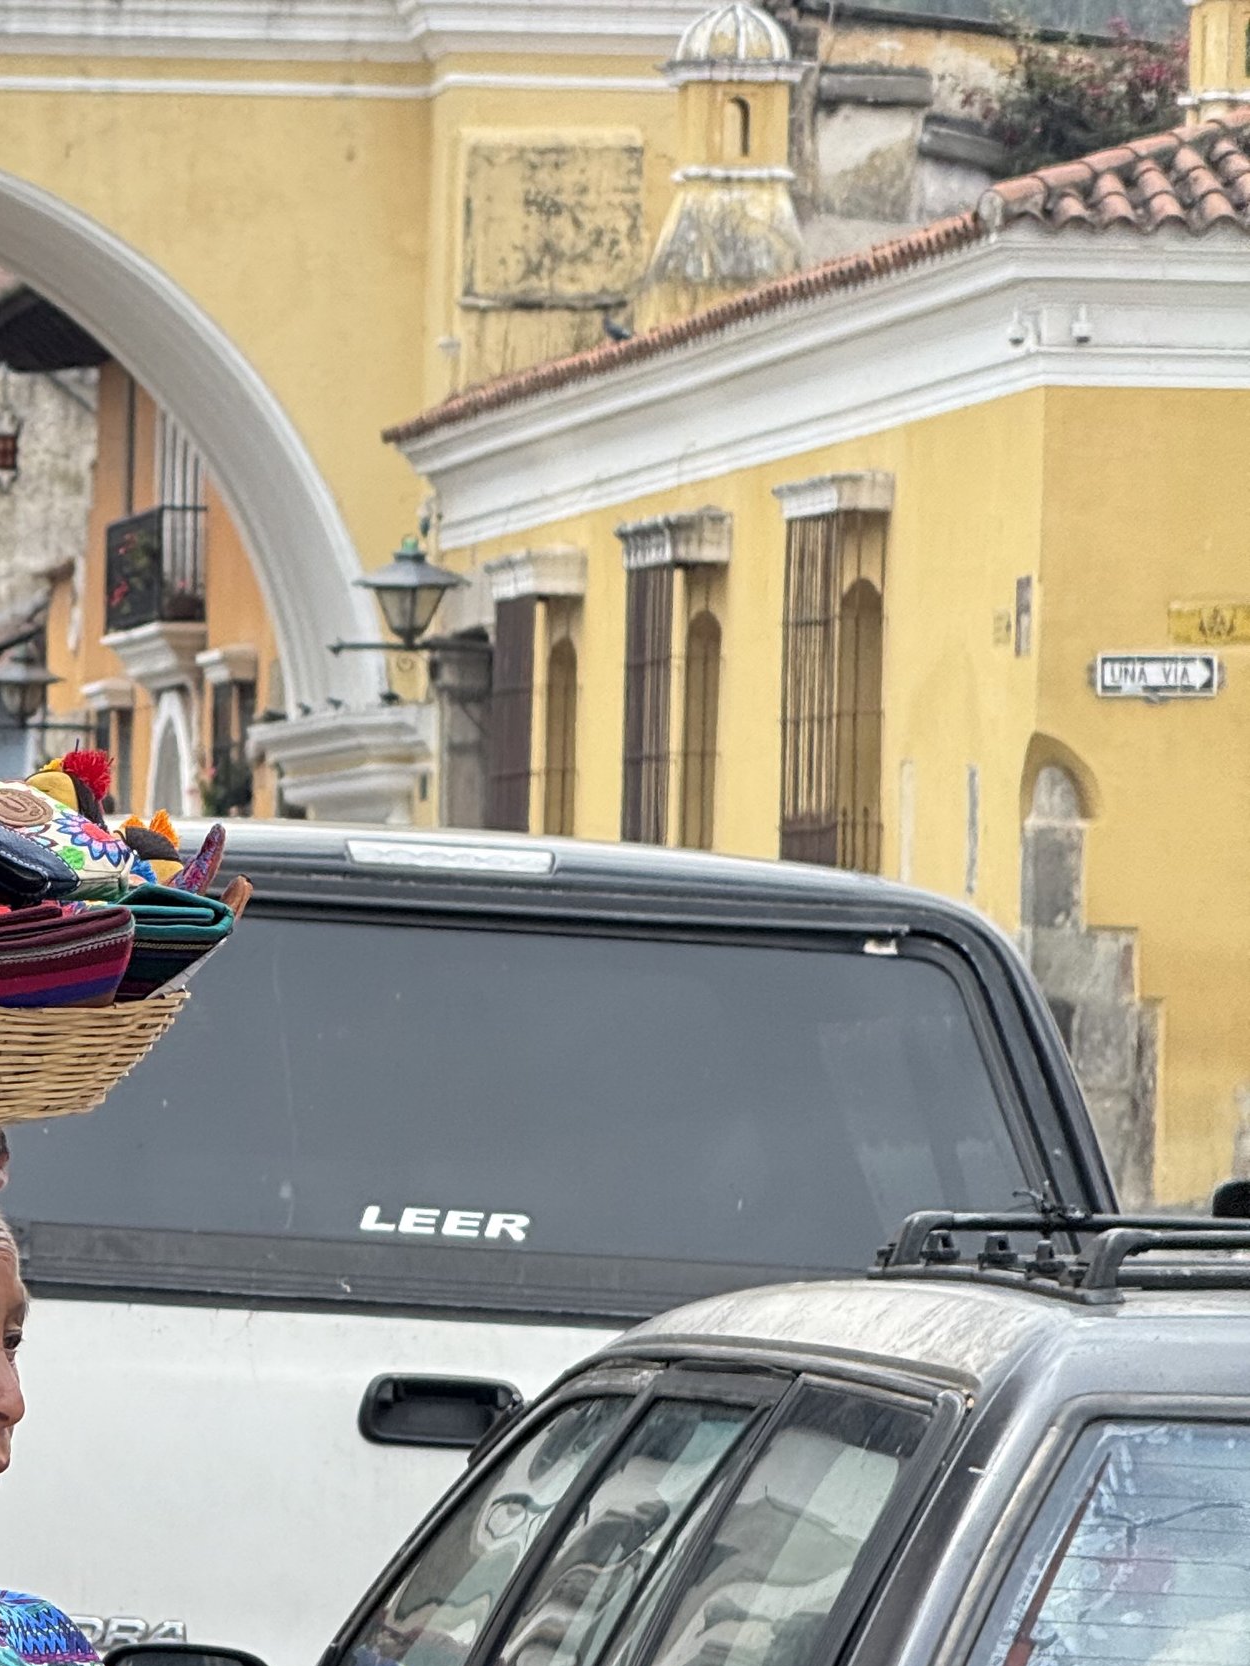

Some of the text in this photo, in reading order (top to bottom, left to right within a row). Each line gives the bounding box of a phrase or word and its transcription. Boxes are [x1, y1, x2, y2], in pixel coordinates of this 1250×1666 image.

[1110, 661, 1191, 685] UNA VIA
[359, 1204, 531, 1242] LEER
